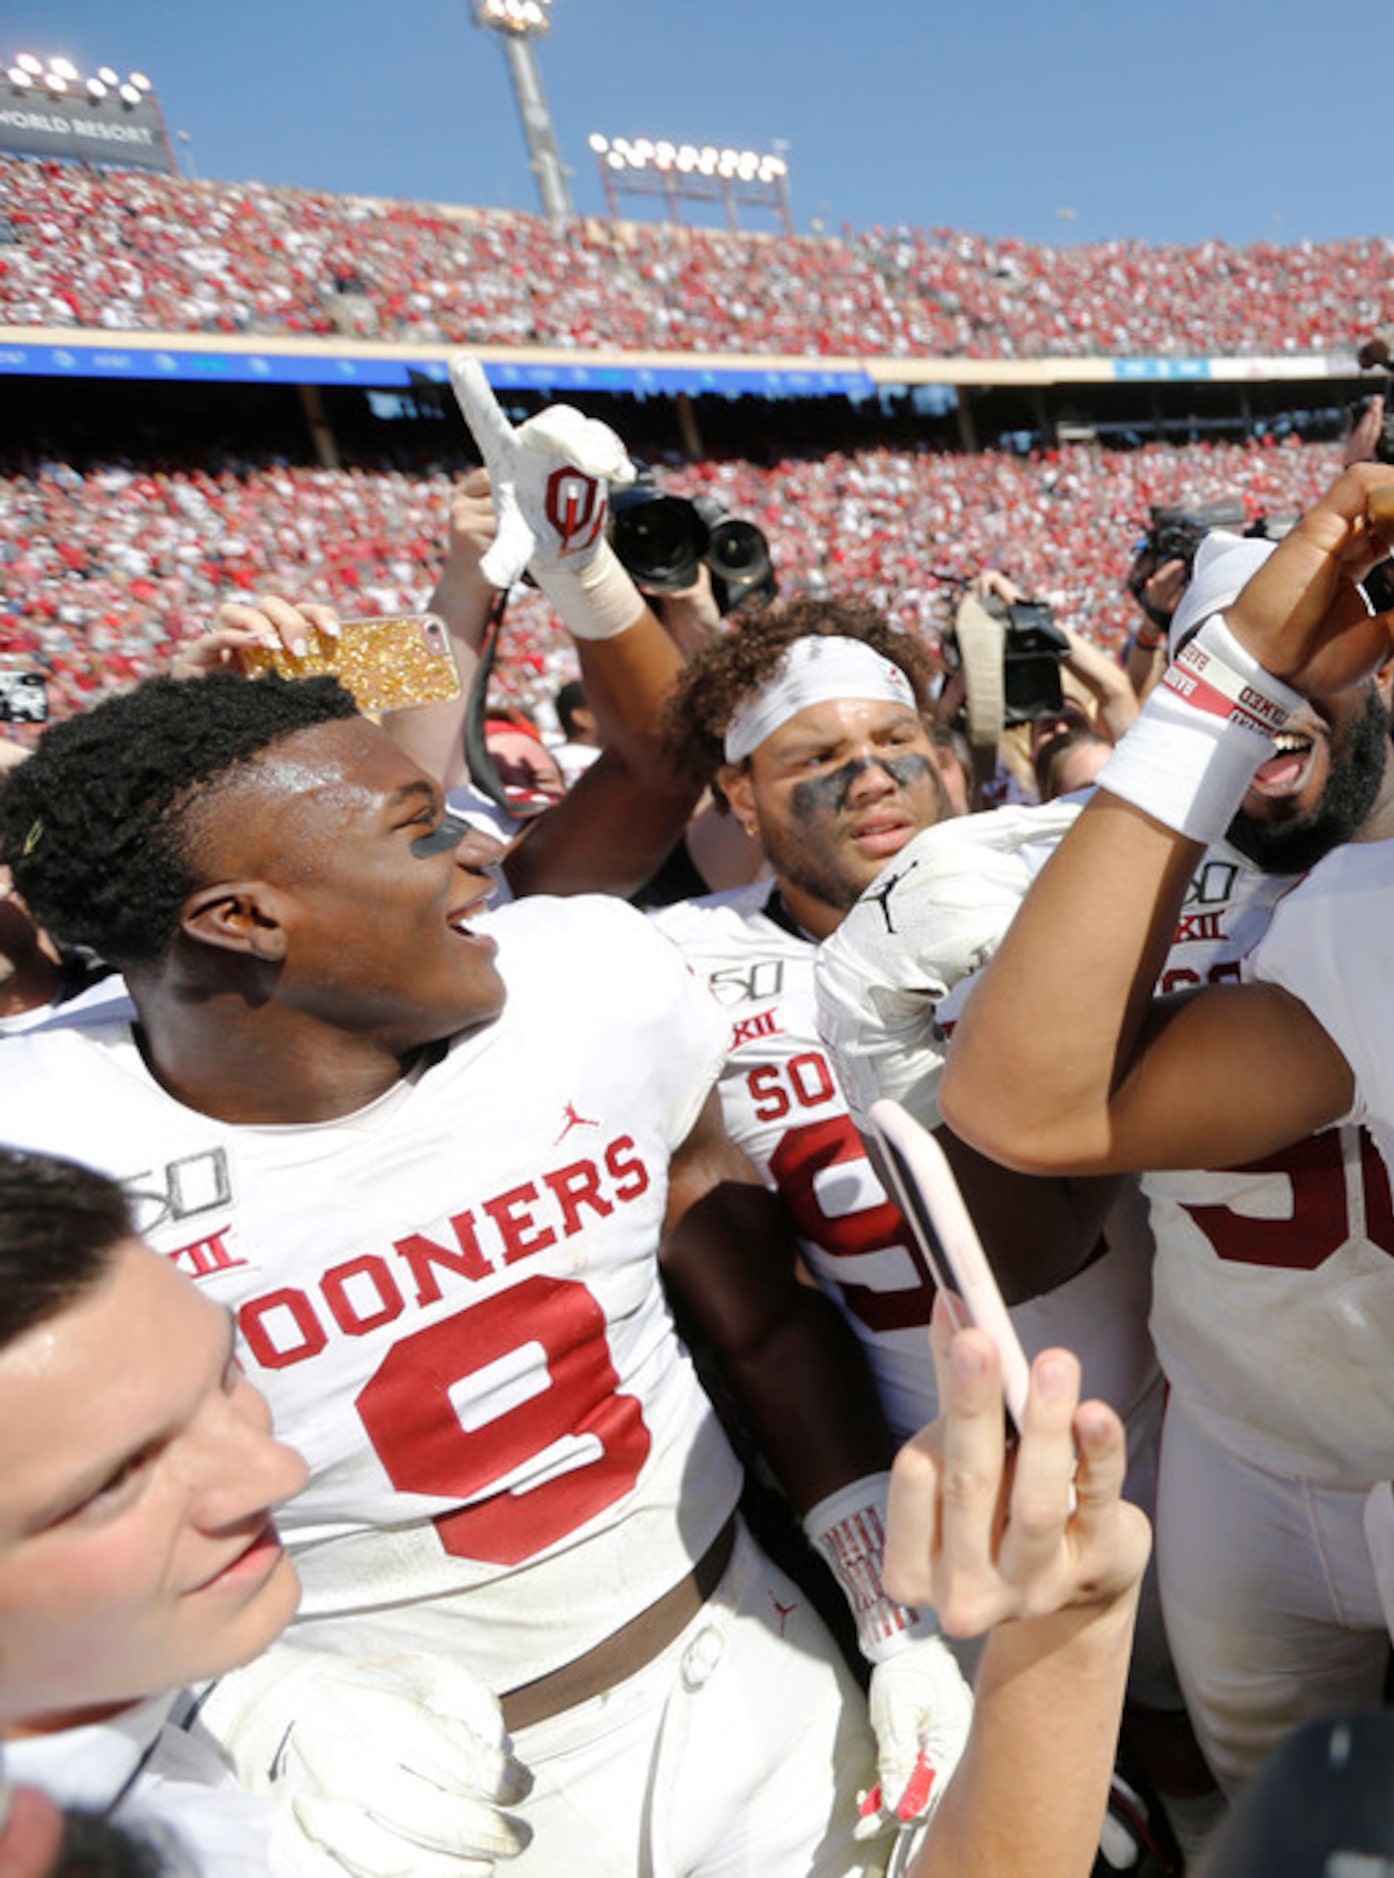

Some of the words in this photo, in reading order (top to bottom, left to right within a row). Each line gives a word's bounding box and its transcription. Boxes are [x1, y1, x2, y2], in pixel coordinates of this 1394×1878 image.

[71, 119, 152, 145] RESORT
[108, 1147, 232, 1236] 50
[236, 1135, 651, 1369] OONERS
[354, 1274, 652, 1567] 9
